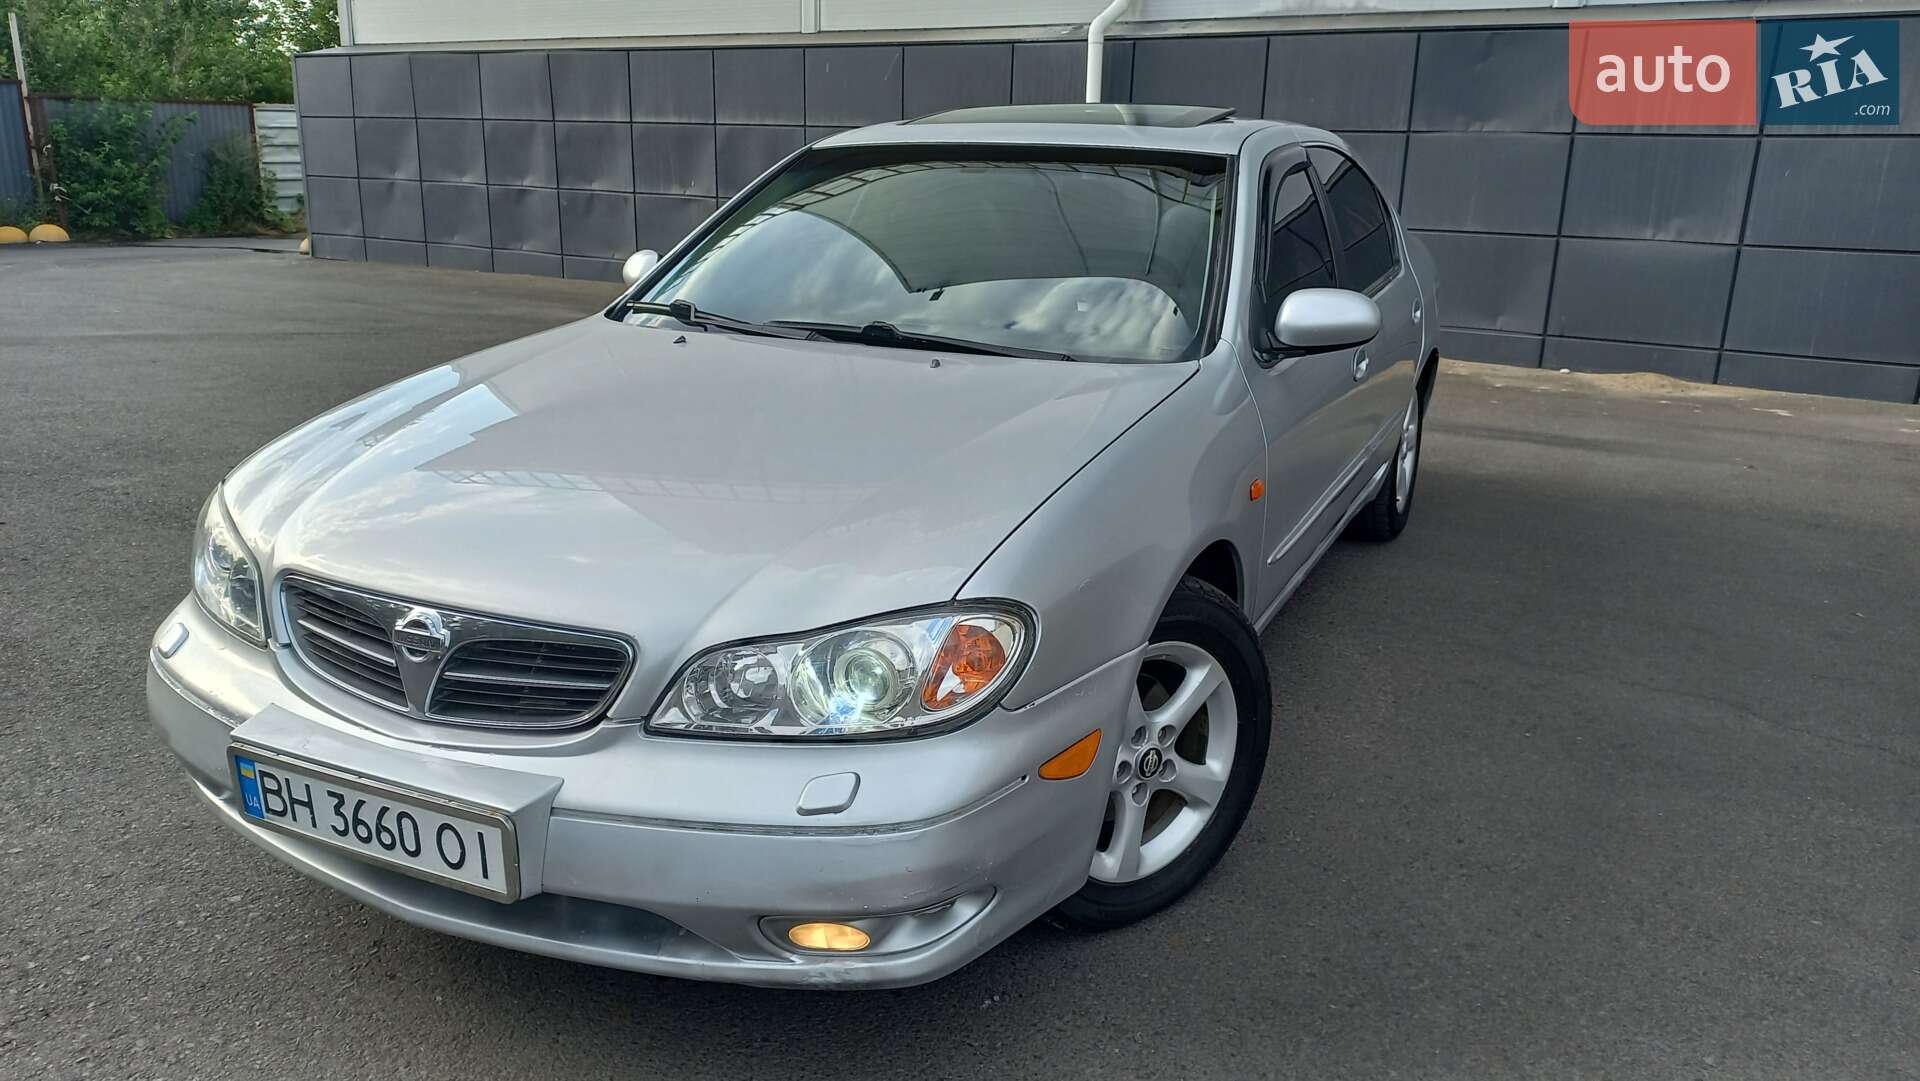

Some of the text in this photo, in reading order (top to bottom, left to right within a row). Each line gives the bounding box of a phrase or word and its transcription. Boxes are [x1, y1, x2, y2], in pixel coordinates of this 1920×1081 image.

[246, 792, 261, 811] UA
[258, 769, 490, 880] BH 3660 OI
